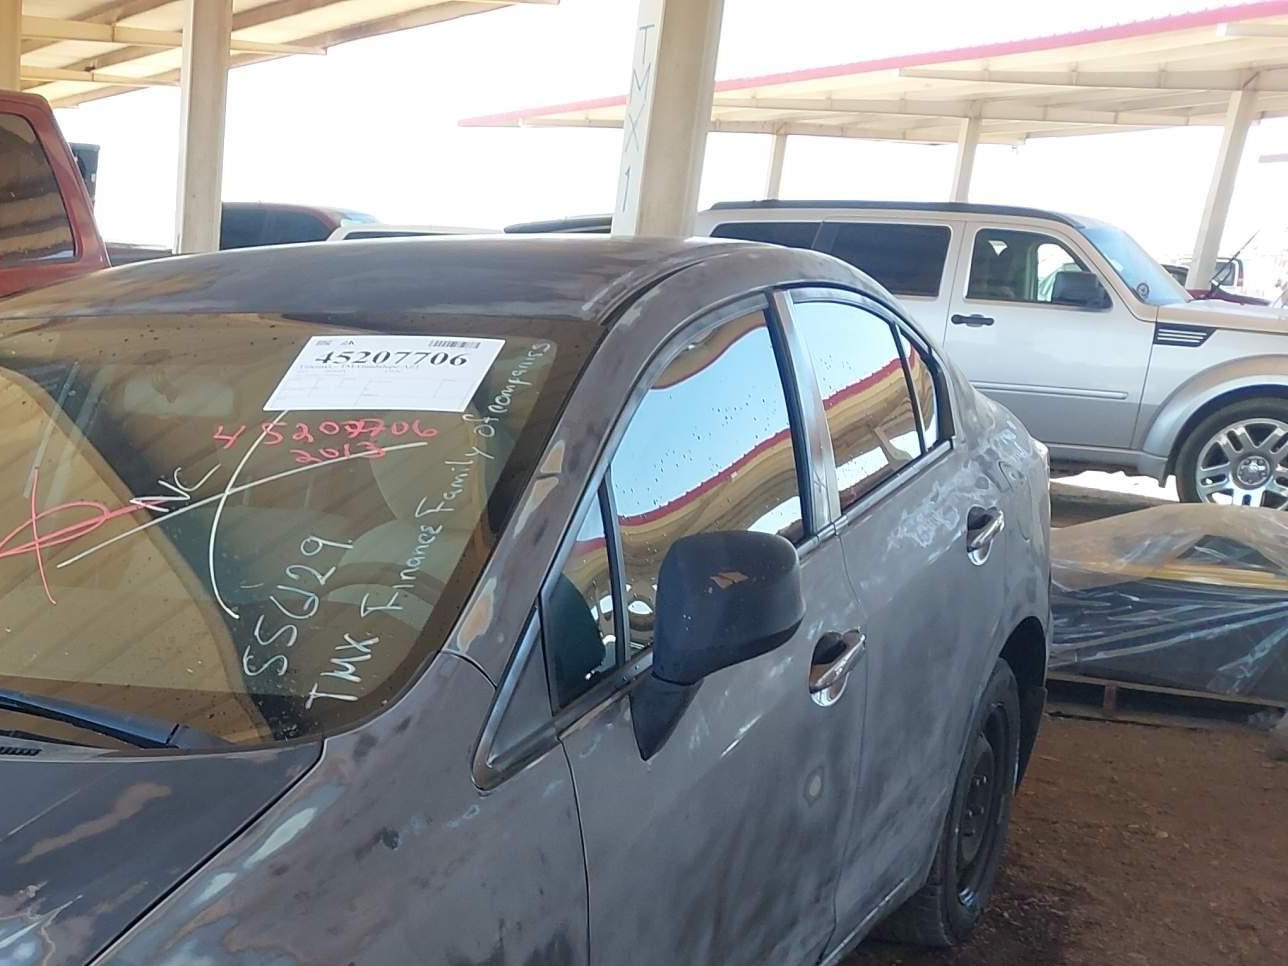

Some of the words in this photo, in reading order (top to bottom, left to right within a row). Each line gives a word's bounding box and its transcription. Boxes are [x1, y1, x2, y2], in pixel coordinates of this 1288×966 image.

[314, 350, 469, 367] 45207706
[304, 632, 380, 709] TMX
[415, 446, 495, 518] Family
